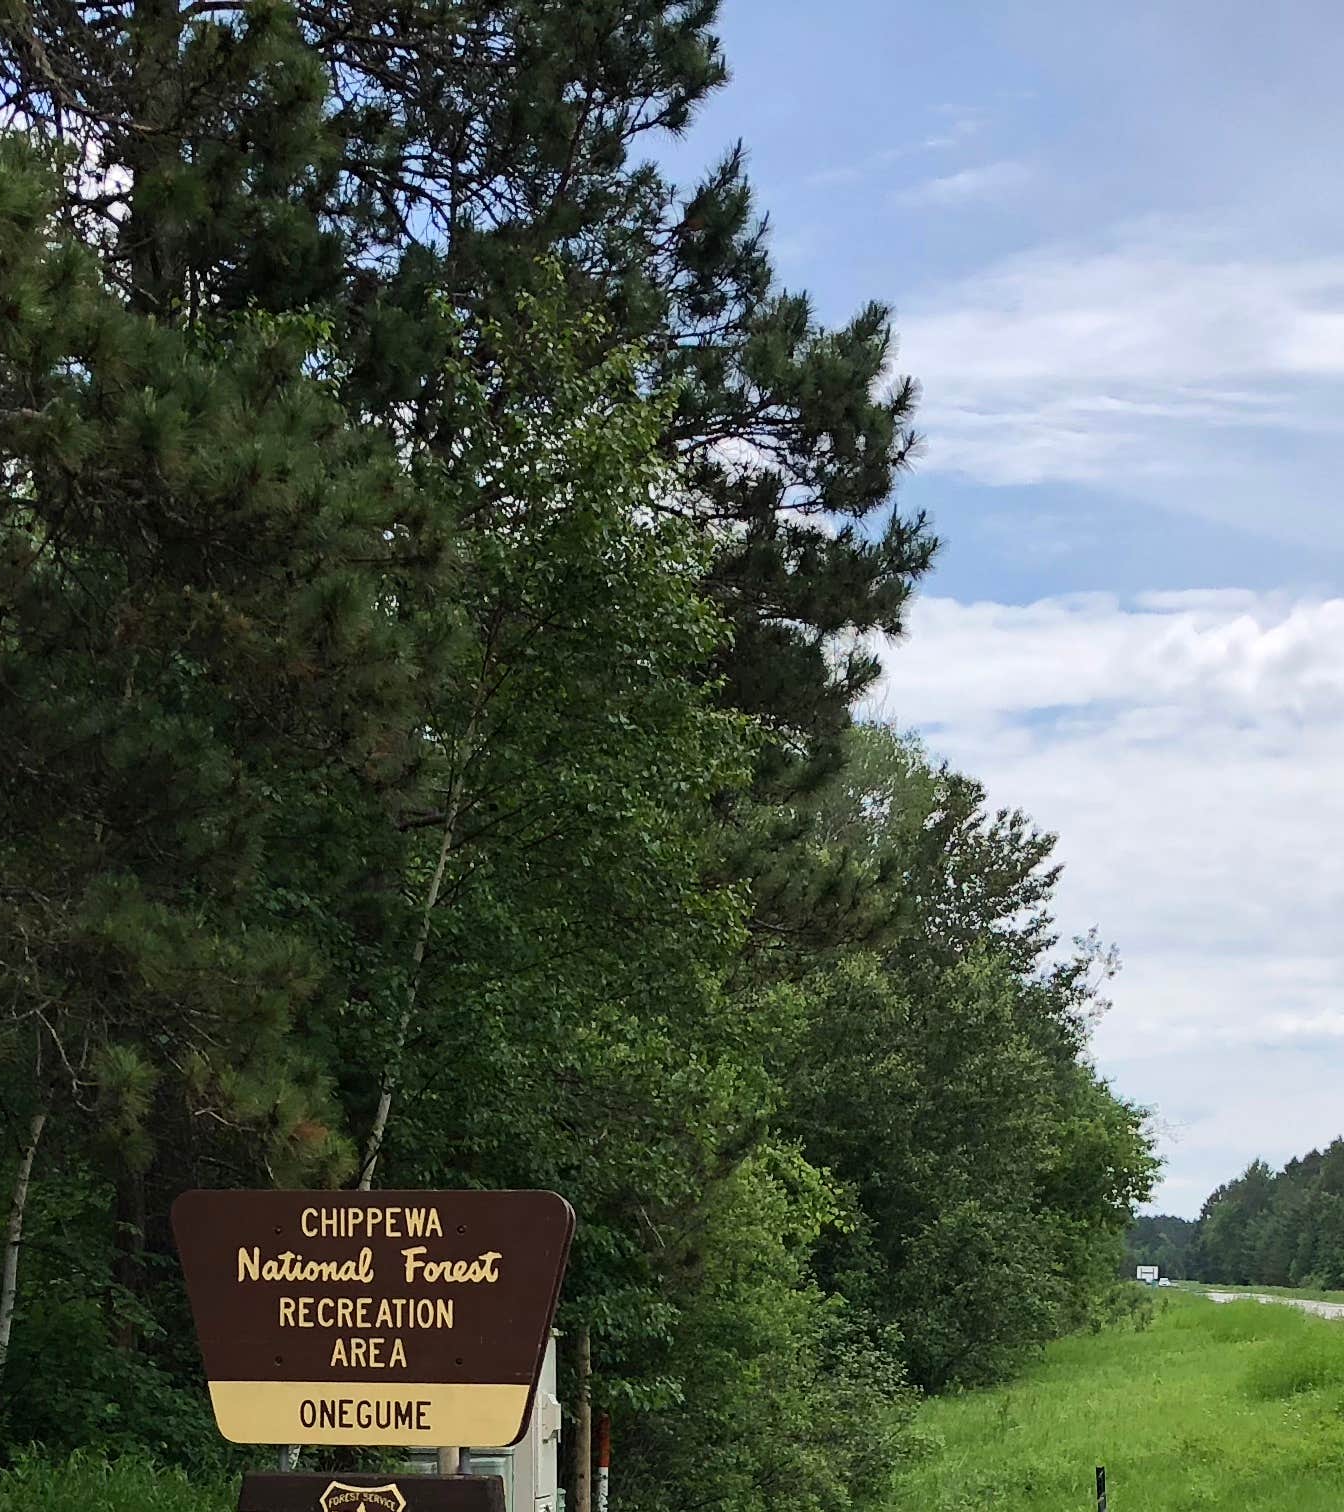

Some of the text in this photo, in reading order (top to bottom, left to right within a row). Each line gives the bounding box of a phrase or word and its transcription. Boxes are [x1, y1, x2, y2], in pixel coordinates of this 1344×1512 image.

[301, 1207, 443, 1238] CHIPPEWA
[238, 1246, 503, 1283] National Forest
[279, 1297, 454, 1329] RECREATION
[330, 1338, 407, 1368] AREA
[300, 1399, 432, 1430] ONEGUME
[328, 1492, 396, 1512] FOREST SERVICE
